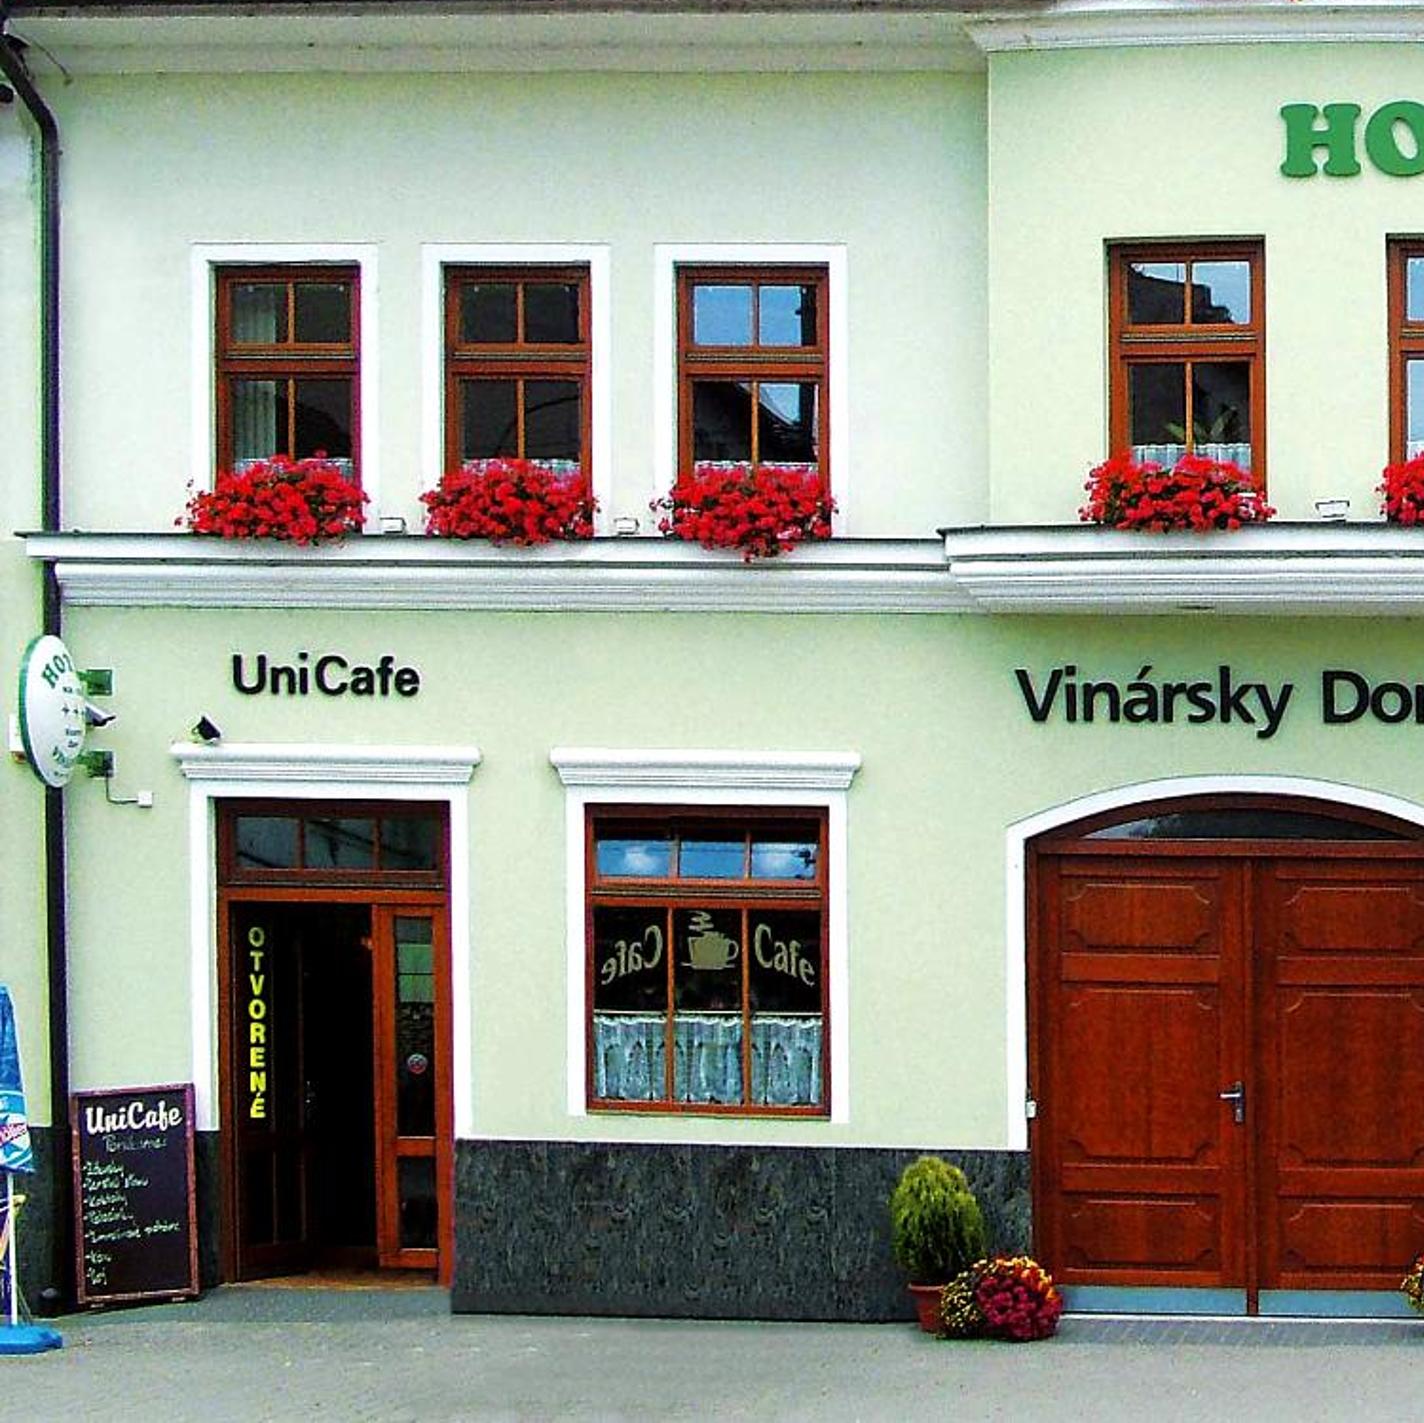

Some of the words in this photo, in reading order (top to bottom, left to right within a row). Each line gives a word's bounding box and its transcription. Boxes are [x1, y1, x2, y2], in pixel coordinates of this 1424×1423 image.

[232, 651, 421, 696] UniCafe
[1014, 665, 1294, 739] Vinársky
[754, 923, 816, 987] Cafe
[248, 926, 267, 1119] OTVORENÉ
[85, 1099, 183, 1135] UniCafe
